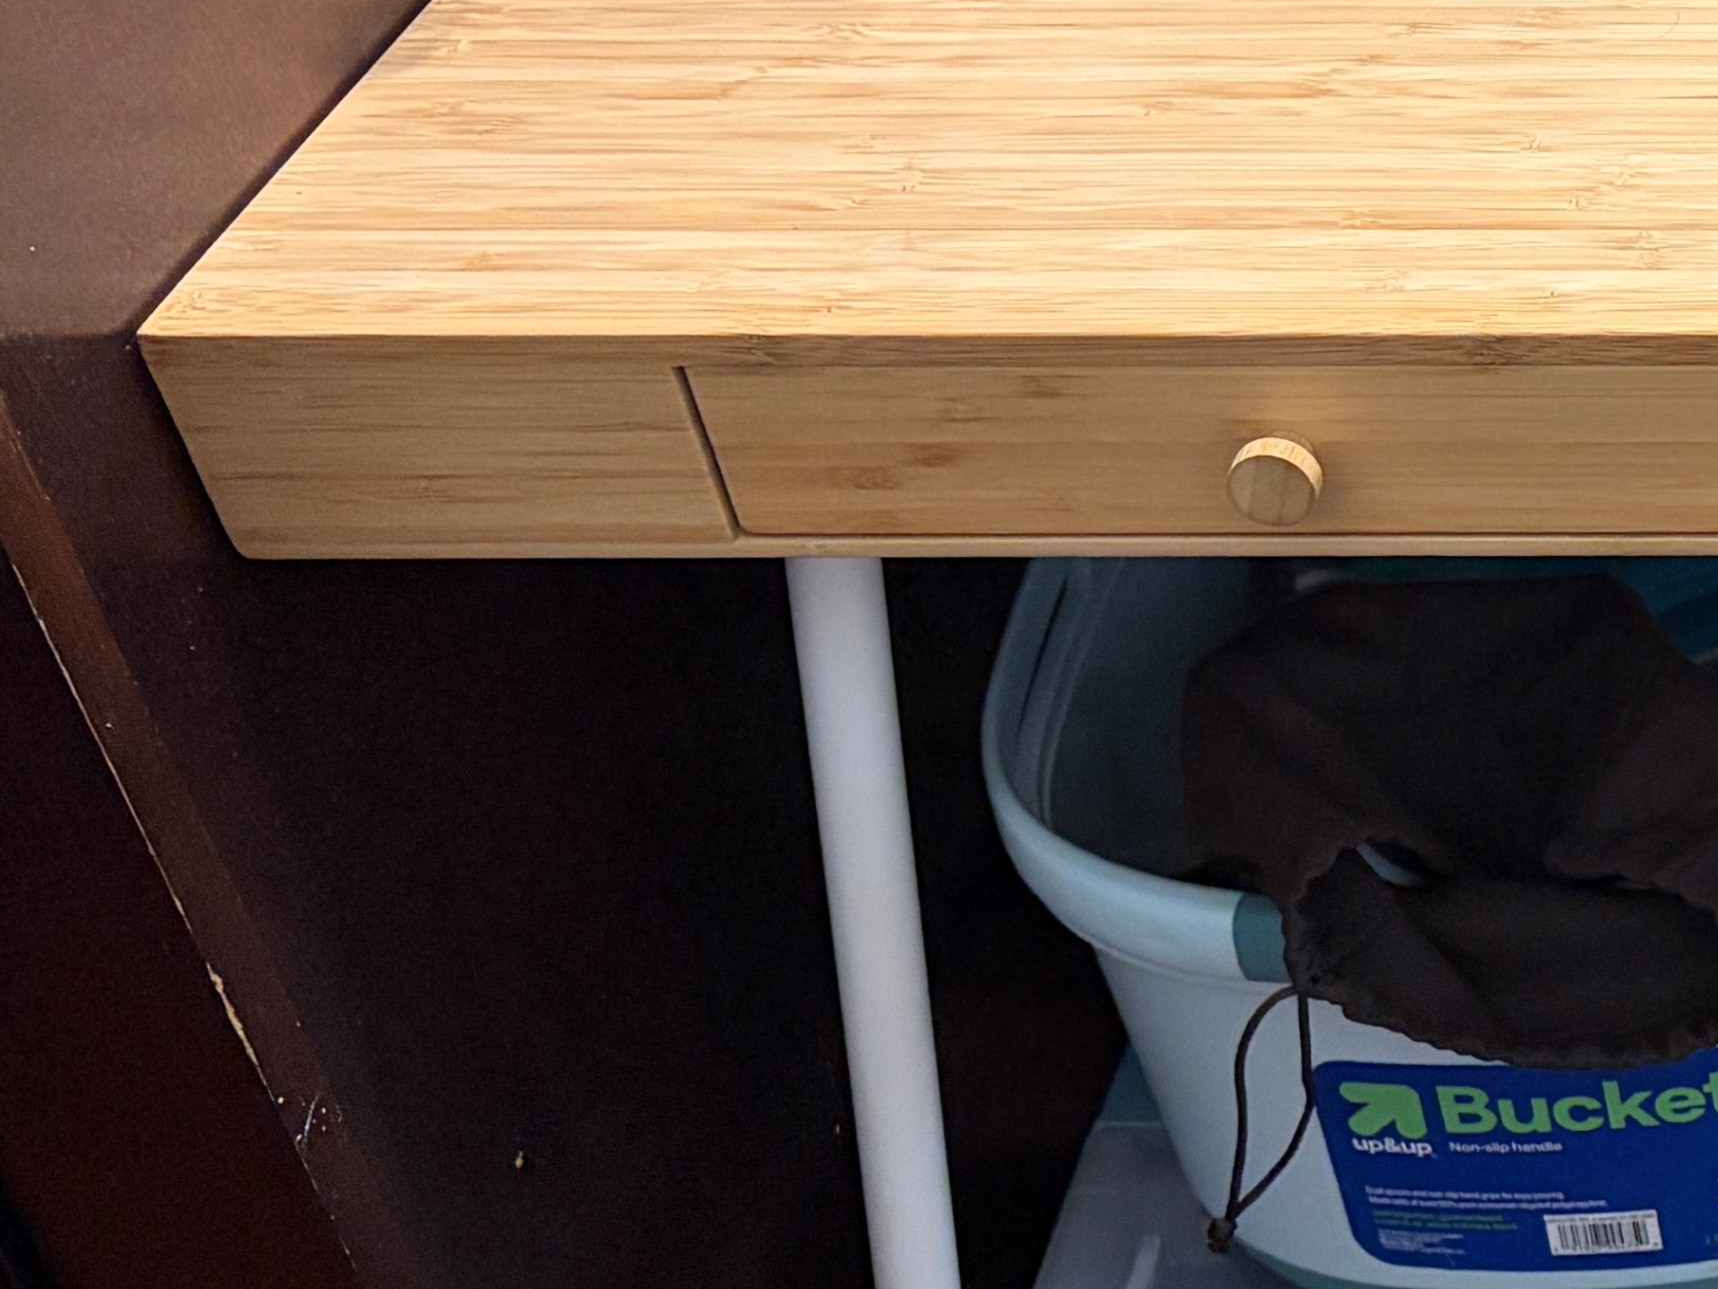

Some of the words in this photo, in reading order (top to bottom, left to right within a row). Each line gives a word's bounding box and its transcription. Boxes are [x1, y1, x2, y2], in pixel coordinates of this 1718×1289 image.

[1352, 1137, 1432, 1157] up&up
[1449, 1141, 1509, 1155] Non-slip
[1511, 1140, 1563, 1153] handle
